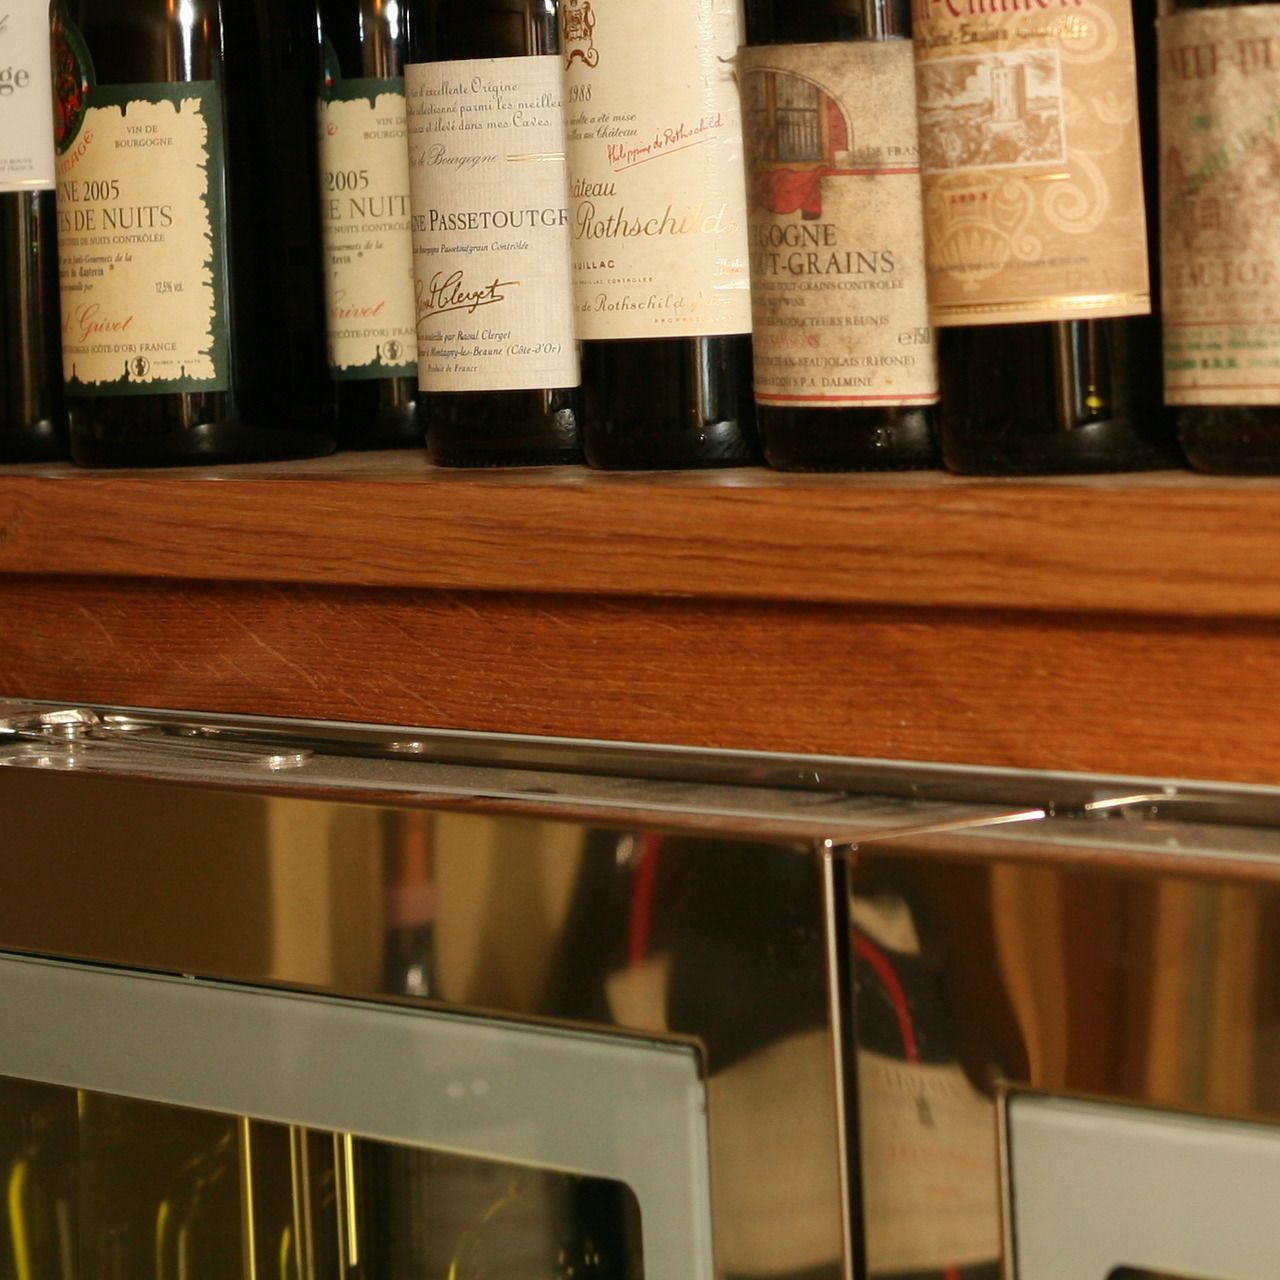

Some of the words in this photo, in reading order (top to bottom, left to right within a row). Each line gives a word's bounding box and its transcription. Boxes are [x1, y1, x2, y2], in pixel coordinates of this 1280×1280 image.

[470, 76, 520, 100] Origine
[569, 84, 592, 104] 1988
[459, 102, 494, 118] parmi
[496, 95, 513, 111] les
[458, 119, 483, 132] dans
[486, 119, 509, 130] mes
[612, 113, 637, 123] mise
[126, 125, 143, 134] VIN
[145, 125, 158, 134] DE
[114, 137, 174, 148] BOURGOGNE
[426, 143, 499, 171] Bourgogne
[328, 169, 369, 192] 2005
[83, 179, 120, 202] 2005
[329, 198, 342, 220] E
[349, 195, 409, 219] NUIT
[74, 208, 96, 232] DE
[102, 205, 173, 230] NUITS
[114, 253, 124, 263] de
[124, 252, 133, 263] la
[480, 329, 511, 342] Clerget
[139, 342, 177, 352] FRANCE
[454, 363, 478, 373] France
